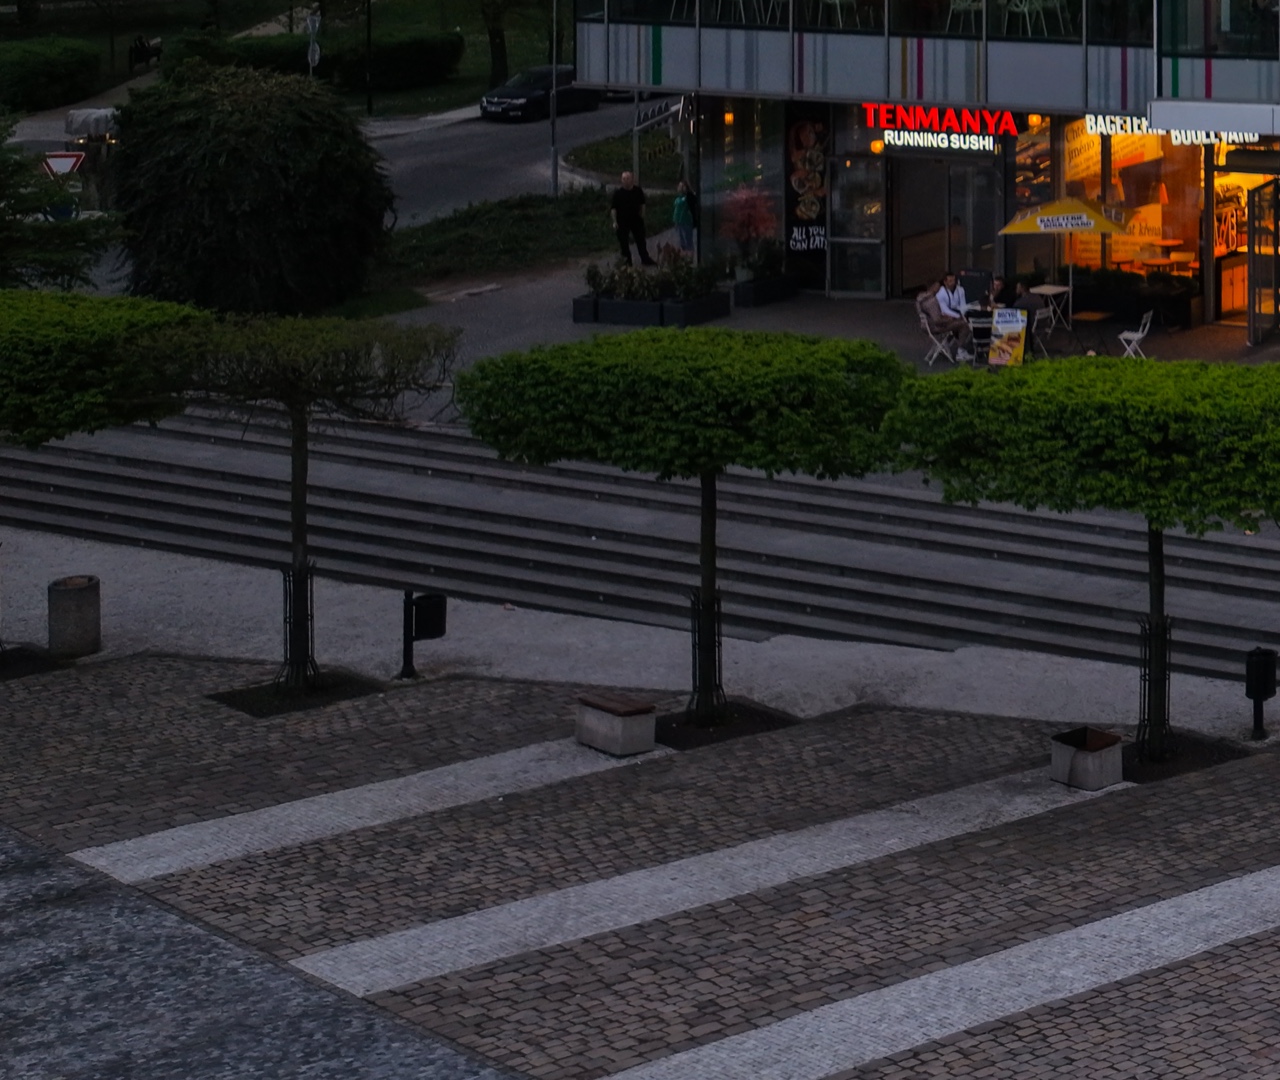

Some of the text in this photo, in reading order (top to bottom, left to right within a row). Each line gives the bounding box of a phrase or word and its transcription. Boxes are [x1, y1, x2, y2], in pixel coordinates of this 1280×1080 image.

[862, 103, 1018, 136] TENMANYA
[884, 130, 994, 151] RUNNING SUSHI
[792, 225, 825, 240] ALL YOU
[789, 238, 808, 251] CAN
